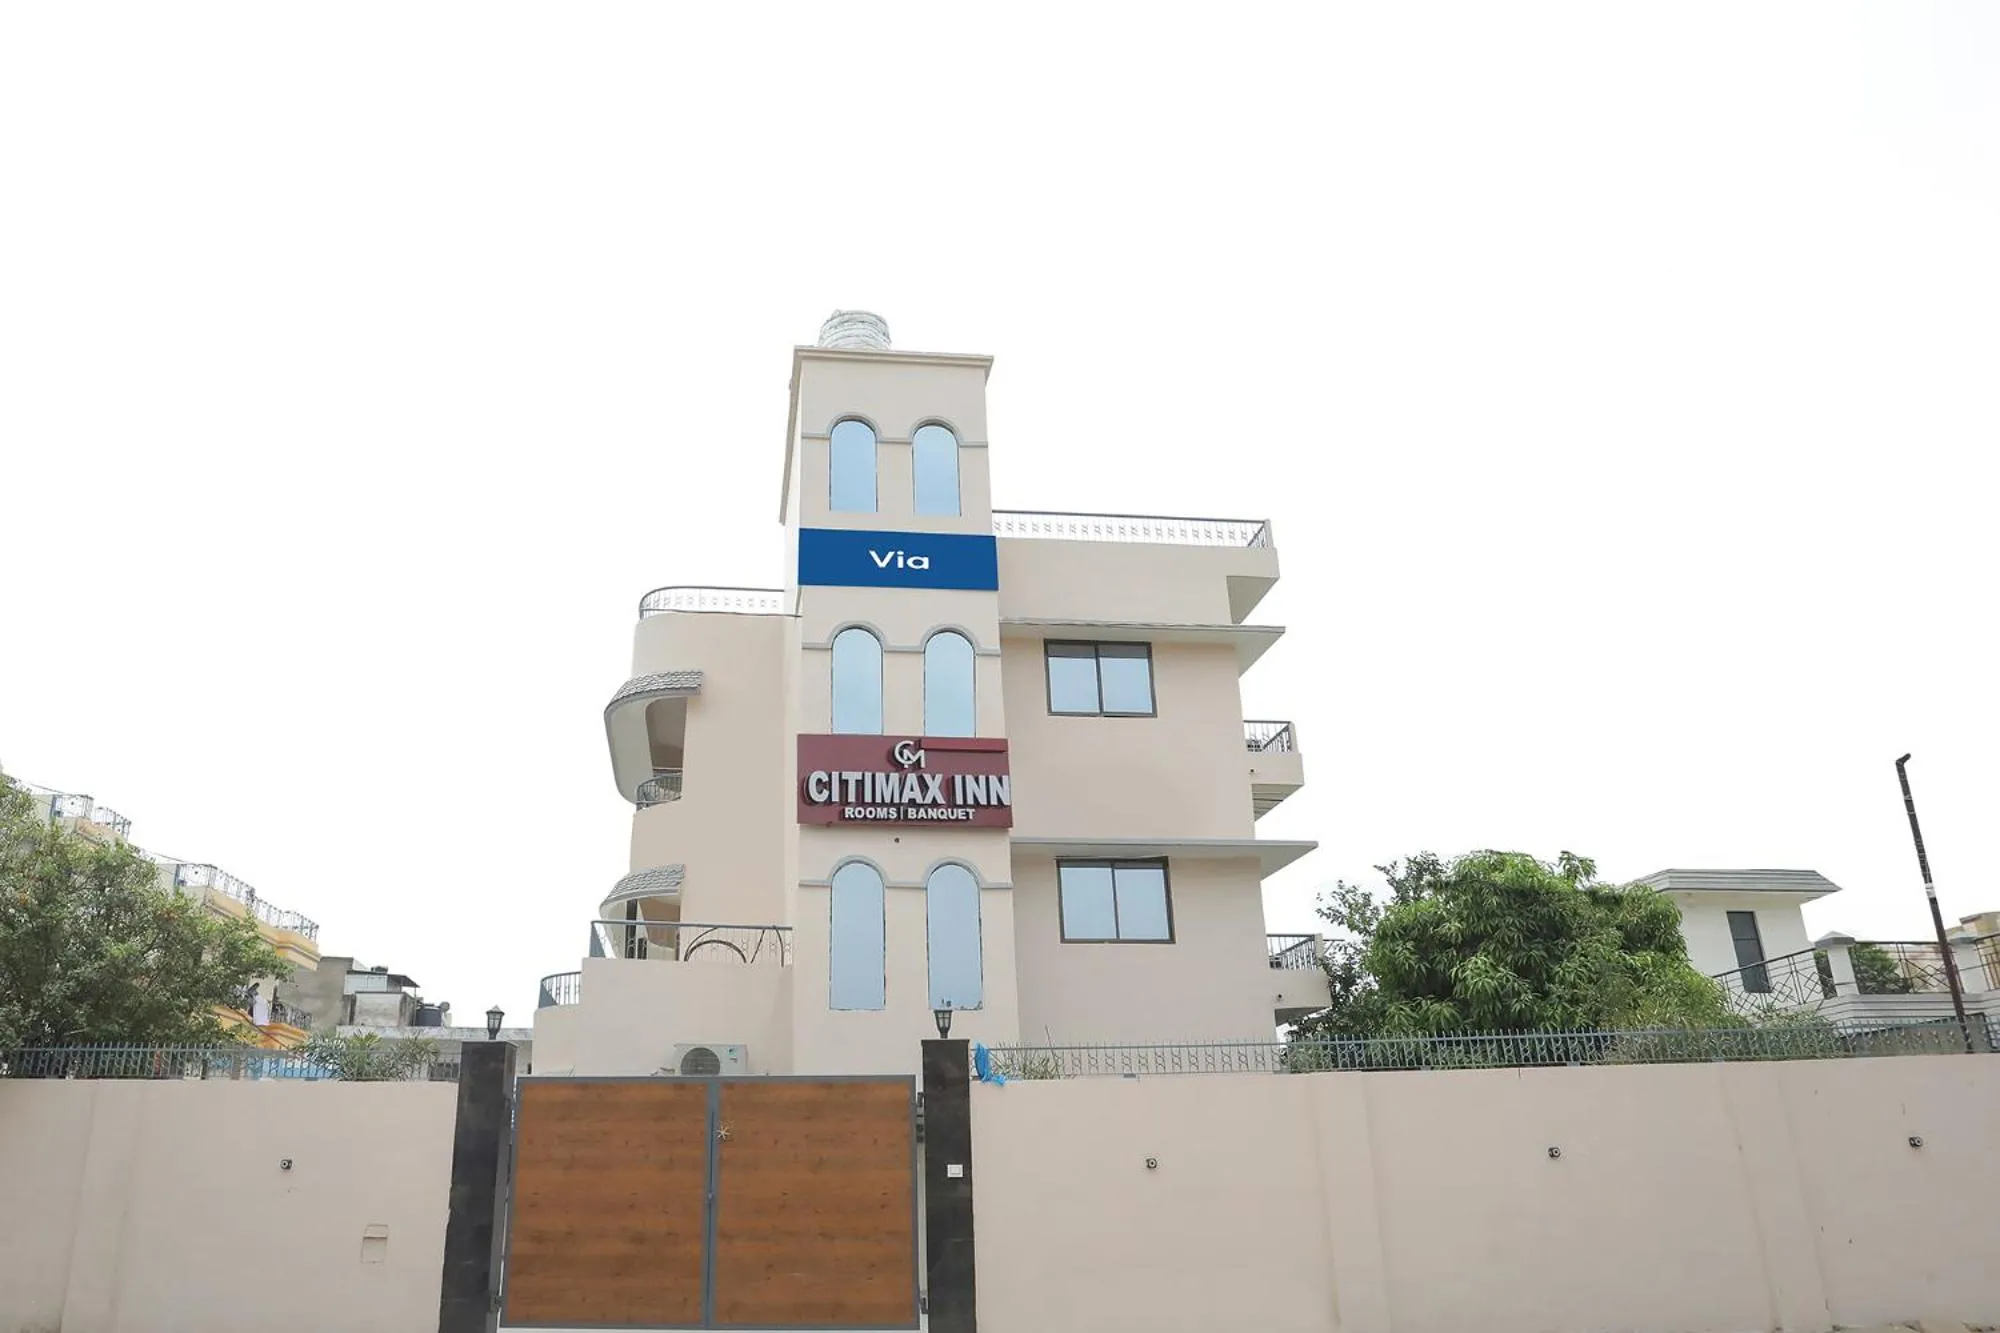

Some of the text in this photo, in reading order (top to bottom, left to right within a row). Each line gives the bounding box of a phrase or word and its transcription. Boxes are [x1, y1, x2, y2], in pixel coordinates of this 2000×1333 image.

[868, 550, 929, 570] Via
[808, 770, 1011, 806] CITIMAX INN
[844, 807, 976, 821] ROOMS BANQUET
